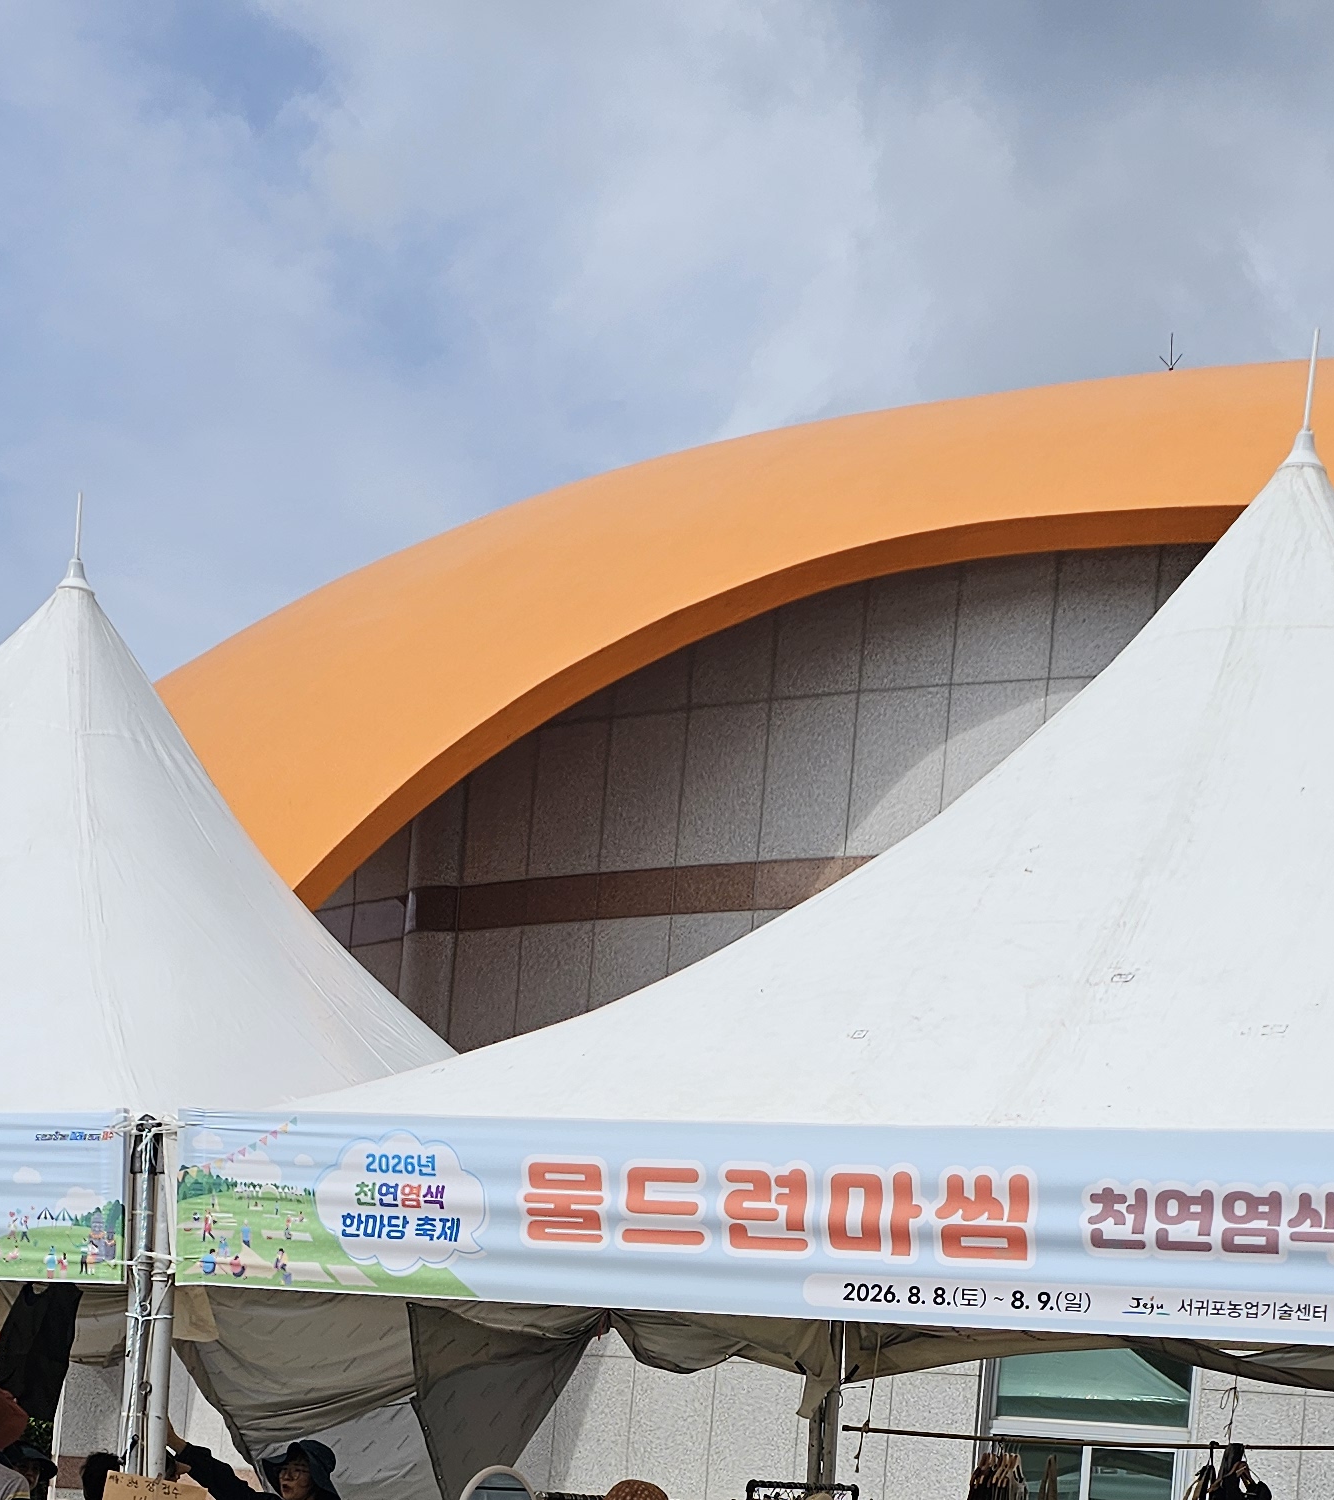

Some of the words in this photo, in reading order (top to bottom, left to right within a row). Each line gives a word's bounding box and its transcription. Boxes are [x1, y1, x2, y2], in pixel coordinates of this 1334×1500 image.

[365, 1153, 437, 1177] 2026년
[354, 1181, 446, 1210] 천연염색
[523, 1161, 1029, 1262] 물드련마씸
[341, 1213, 410, 1240] 한마당
[414, 1216, 461, 1242] 축제
[842, 1282, 901, 1304] 2026.
[907, 1286, 926, 1305] 8.
[932, 1286, 987, 1308] 8.(토)
[1010, 1290, 1030, 1310] 8.
[1037, 1290, 1091, 1314] 9.(일)
[1123, 1295, 1170, 1316] Jeju
[1177, 1299, 1328, 1322] 서귀포농업기술센터
